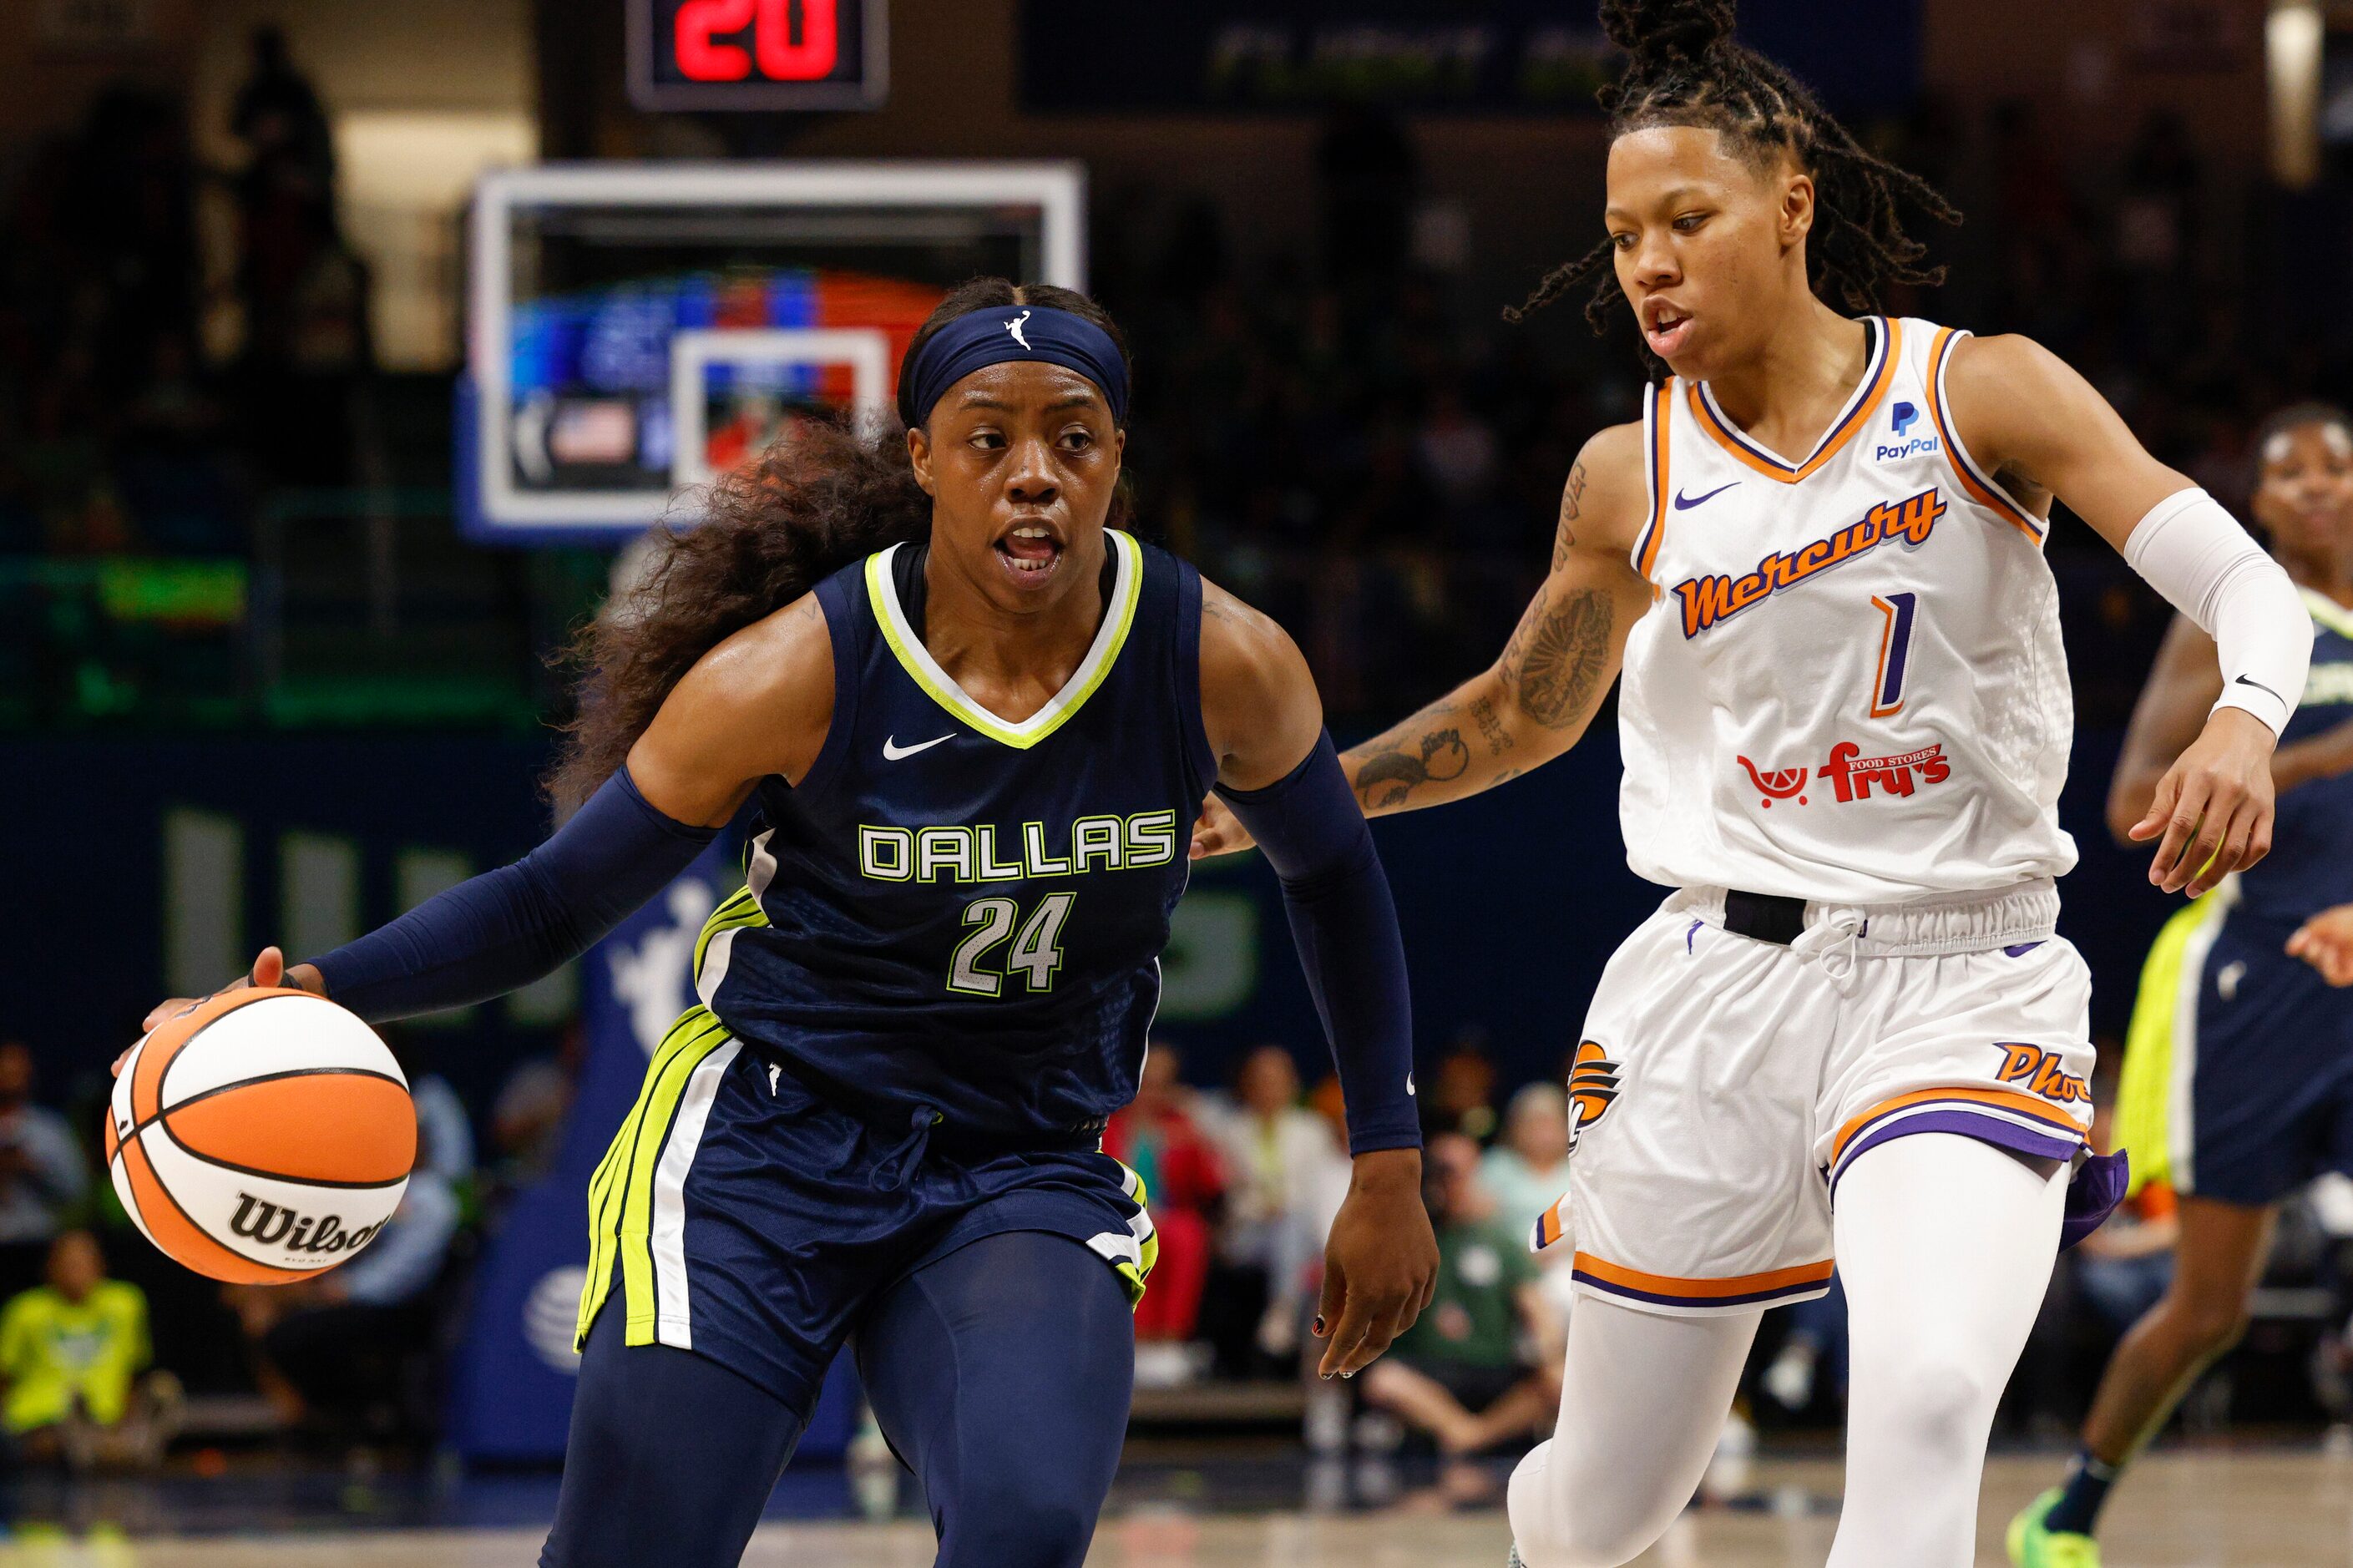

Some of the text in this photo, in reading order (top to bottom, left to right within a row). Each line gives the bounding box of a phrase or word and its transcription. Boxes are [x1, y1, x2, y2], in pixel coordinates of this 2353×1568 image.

[674, 0, 838, 81] 20
[1876, 436, 1938, 461] PayPal
[1670, 486, 1948, 641] Mercury
[1870, 589, 1920, 720] 1
[1817, 741, 1951, 803] fry's
[1848, 746, 1938, 771] FOOD STORES
[858, 808, 1176, 884] DALLAS
[945, 891, 1078, 999] 24
